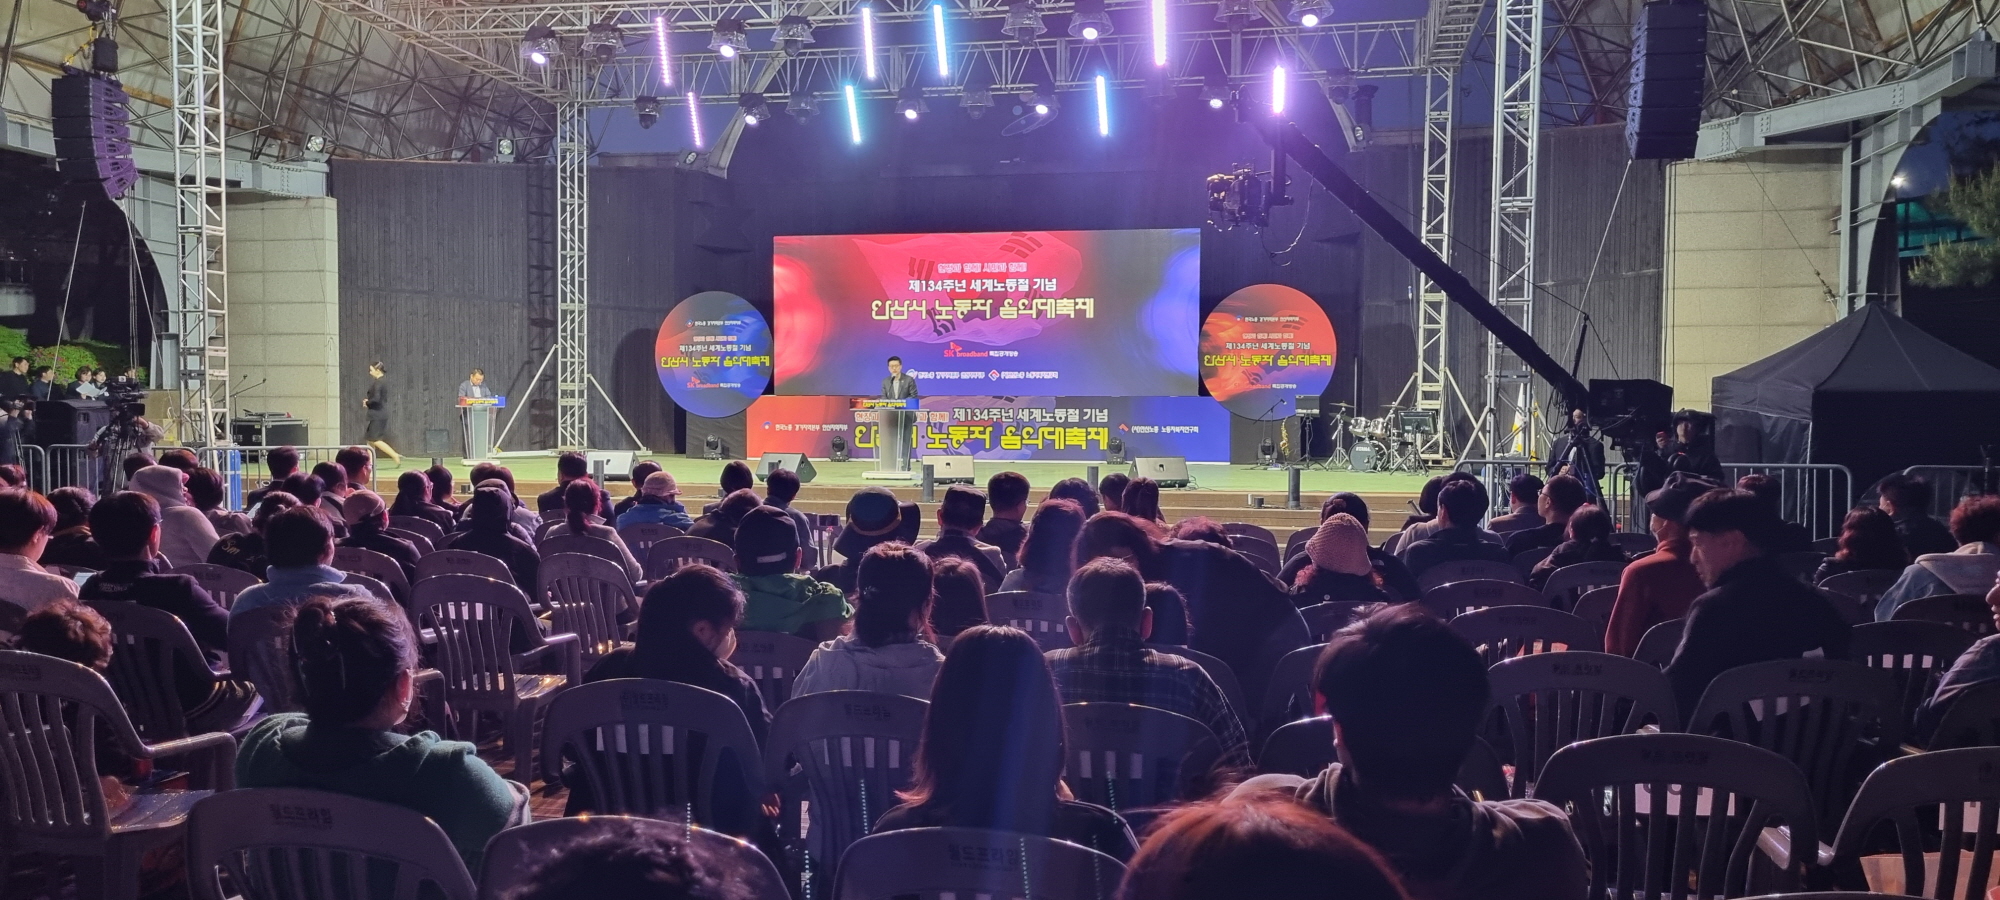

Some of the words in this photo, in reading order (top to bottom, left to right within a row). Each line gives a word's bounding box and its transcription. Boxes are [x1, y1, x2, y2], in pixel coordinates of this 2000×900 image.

[908, 280, 966, 292] 제134주년
[970, 279, 1029, 292] 세계노동절
[1033, 278, 1056, 291] 기념
[872, 300, 926, 320] 안산시
[935, 300, 992, 319] 노동자
[953, 408, 1013, 422] 제134주년
[1017, 408, 1080, 422] 세계노동절
[1083, 408, 1108, 422] 기념
[926, 426, 992, 450] 노동자
